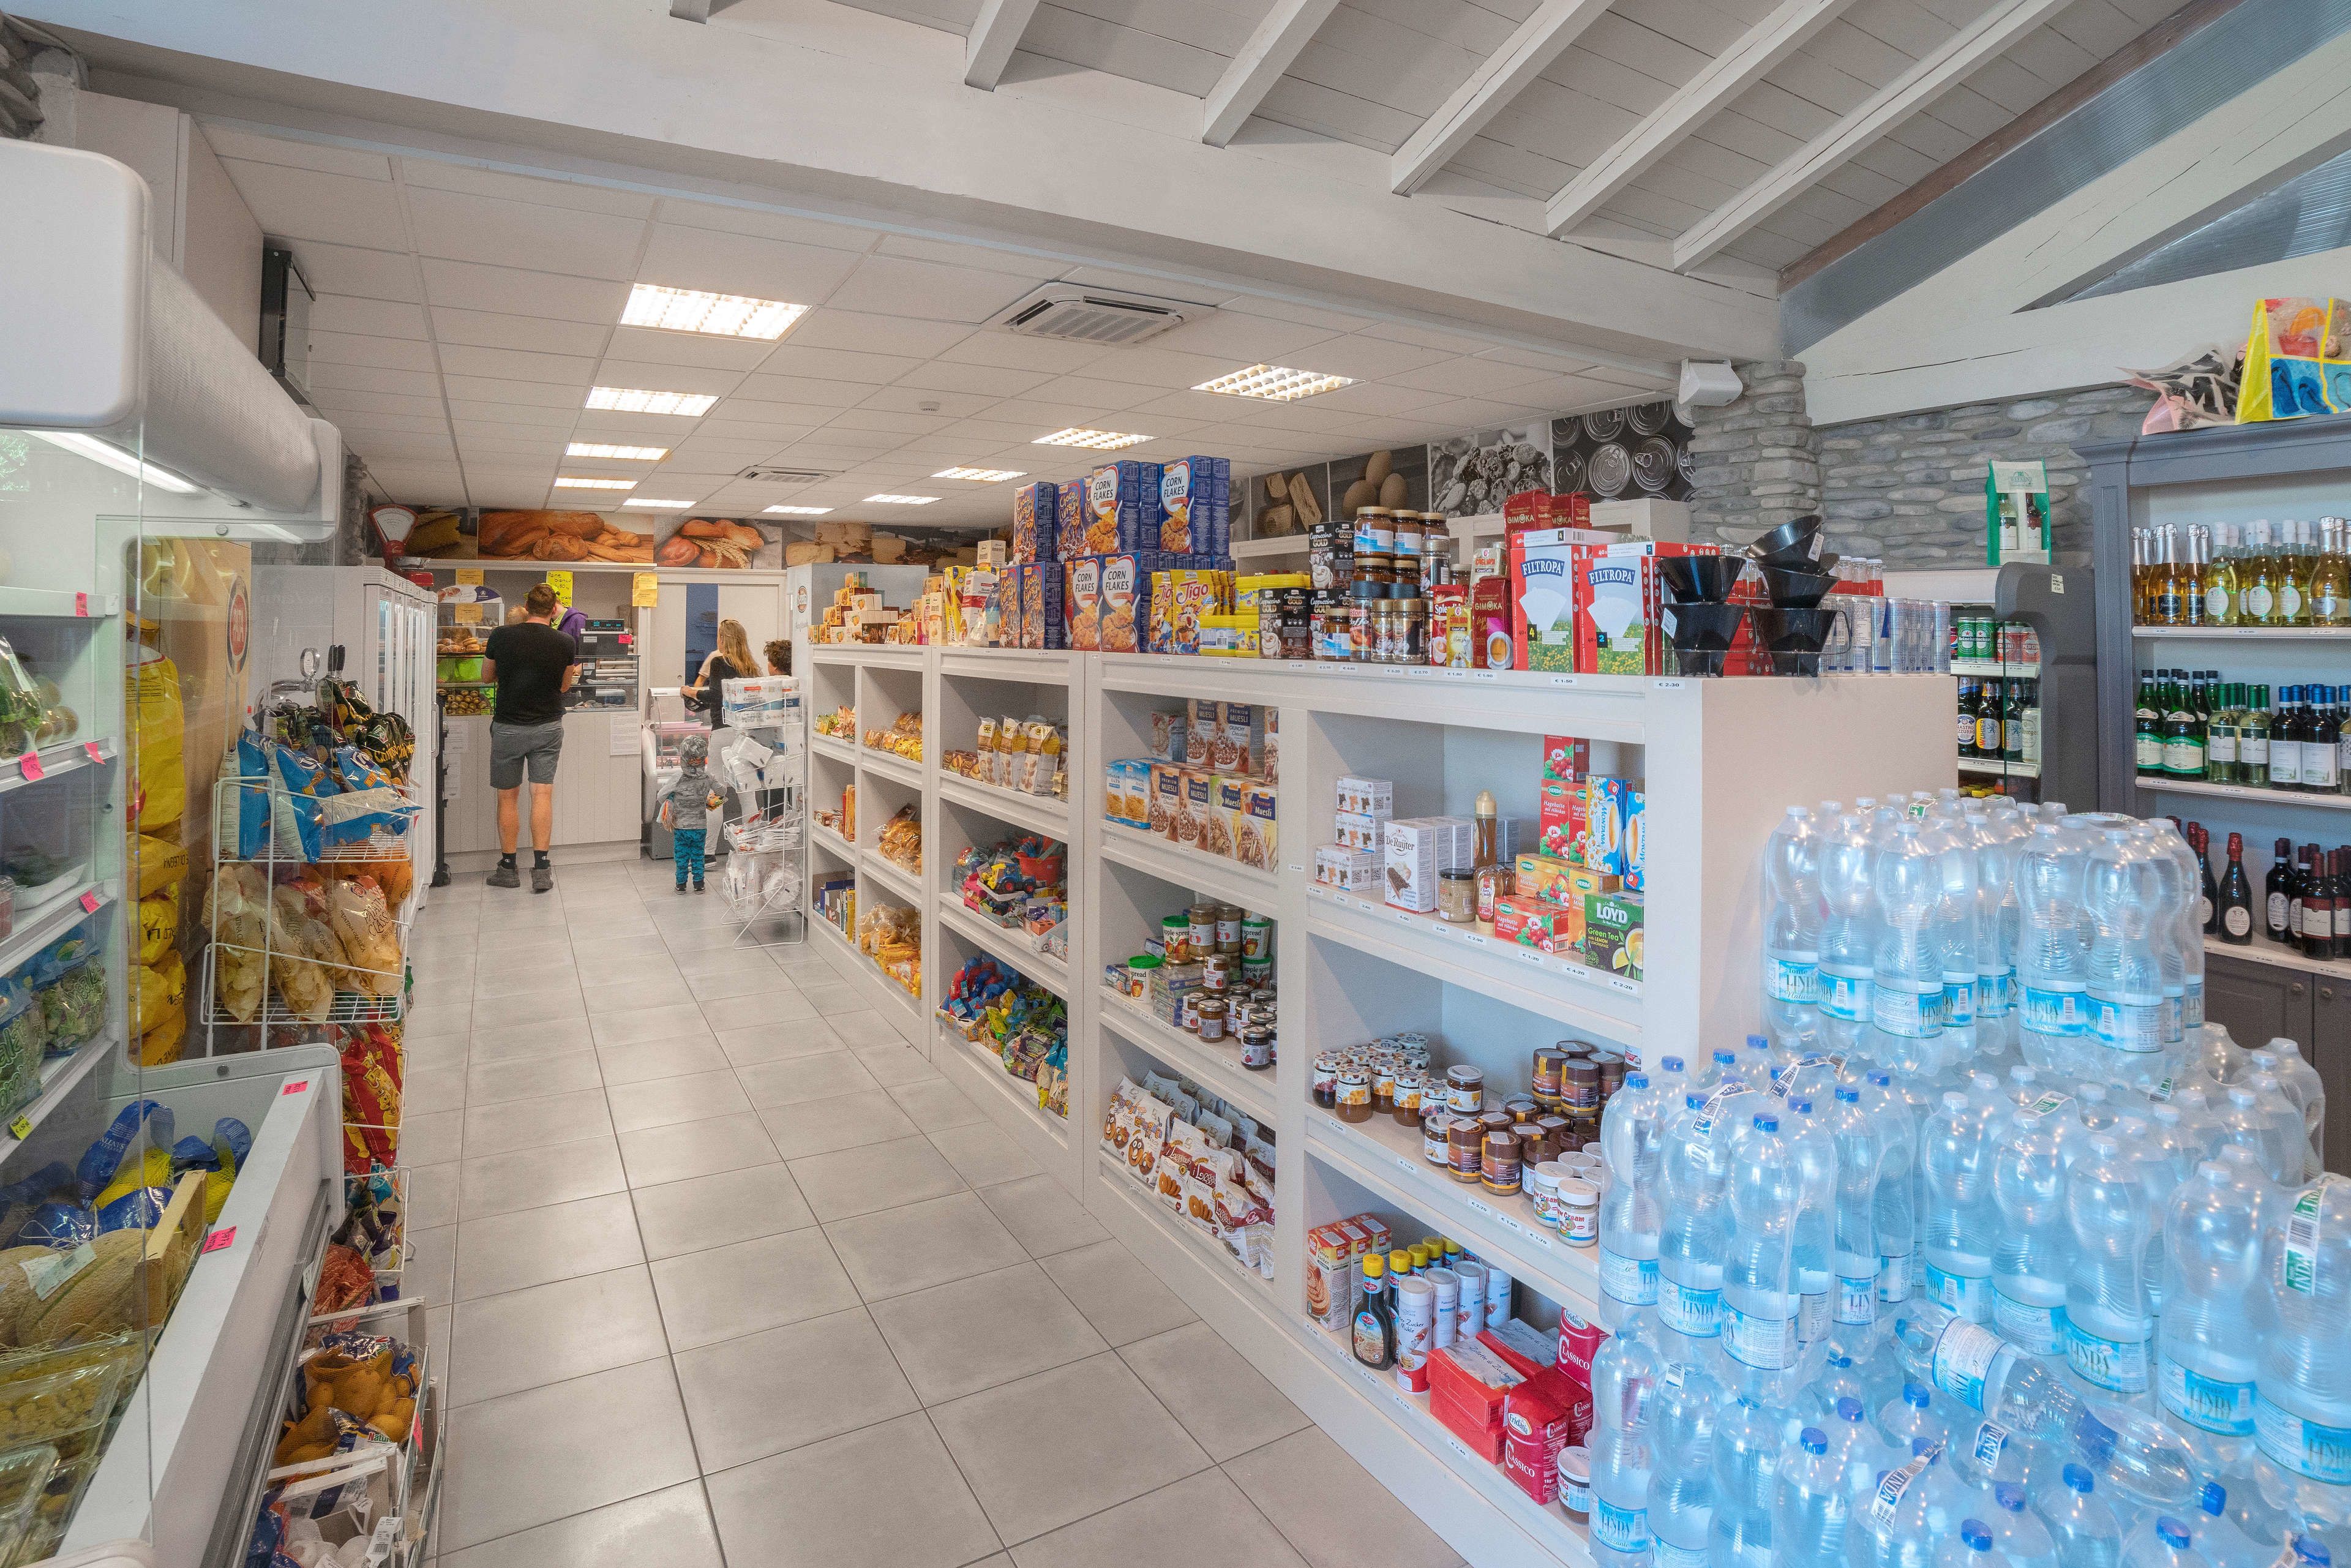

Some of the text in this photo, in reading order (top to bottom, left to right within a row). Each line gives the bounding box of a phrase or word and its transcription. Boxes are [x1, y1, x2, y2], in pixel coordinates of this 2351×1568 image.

[1095, 479, 1111, 490] CORN
[1166, 476, 1182, 487] CORN
[1093, 489, 1113, 501] FLAKES
[1163, 486, 1185, 498] FLAKES
[1507, 514, 1534, 524] GIMOKA
[1558, 531, 1563, 539] 4
[1522, 559, 1562, 576] FILTROPA
[1077, 572, 1092, 582] CORN
[1108, 570, 1127, 580] CORN
[1589, 568, 1634, 584] FILTROPA
[1075, 582, 1094, 592] FLAKES
[1105, 580, 1129, 591] FLAKES
[1475, 601, 1503, 610] GIMOKA
[1529, 626, 1535, 637] 4
[1161, 784, 1177, 792] MUESLI
[1191, 790, 1206, 799] MUESLI
[1224, 797, 1240, 807] Muesli
[1543, 800, 1565, 809] Hagebutte
[1254, 807, 1272, 817] Muesli
[1385, 835, 1415, 851] De Ruijter
[1520, 861, 1534, 870] HERBA
[1499, 904, 1513, 913] HERBA
[1596, 901, 1628, 925] LOYD
[1497, 915, 1518, 926] Hagebutte
[1588, 927, 1619, 942] Green Tea
[2028, 1001, 2058, 1016] LINDA
[1539, 1193, 1557, 1204] Cream
[1564, 1212, 1584, 1222] Cream
[1685, 1292, 1706, 1302] fonte
[1682, 1301, 1714, 1317] LINDA
[1406, 1318, 1424, 1327] Zucker
[1565, 1311, 1584, 1329] Eridania
[1683, 1321, 1712, 1333] Frizzante
[1558, 1334, 1590, 1370] CLASSICO
[2070, 1337, 2109, 1369] LINDA
[2189, 1387, 2232, 1411] LINDA
[1509, 1412, 1529, 1433] Eridania
[1547, 1422, 1566, 1439] CLASSICO
[1981, 1427, 2004, 1467] LINDA
[1505, 1439, 1535, 1477] CLASSICO
[1602, 1513, 1630, 1534] LINDA
